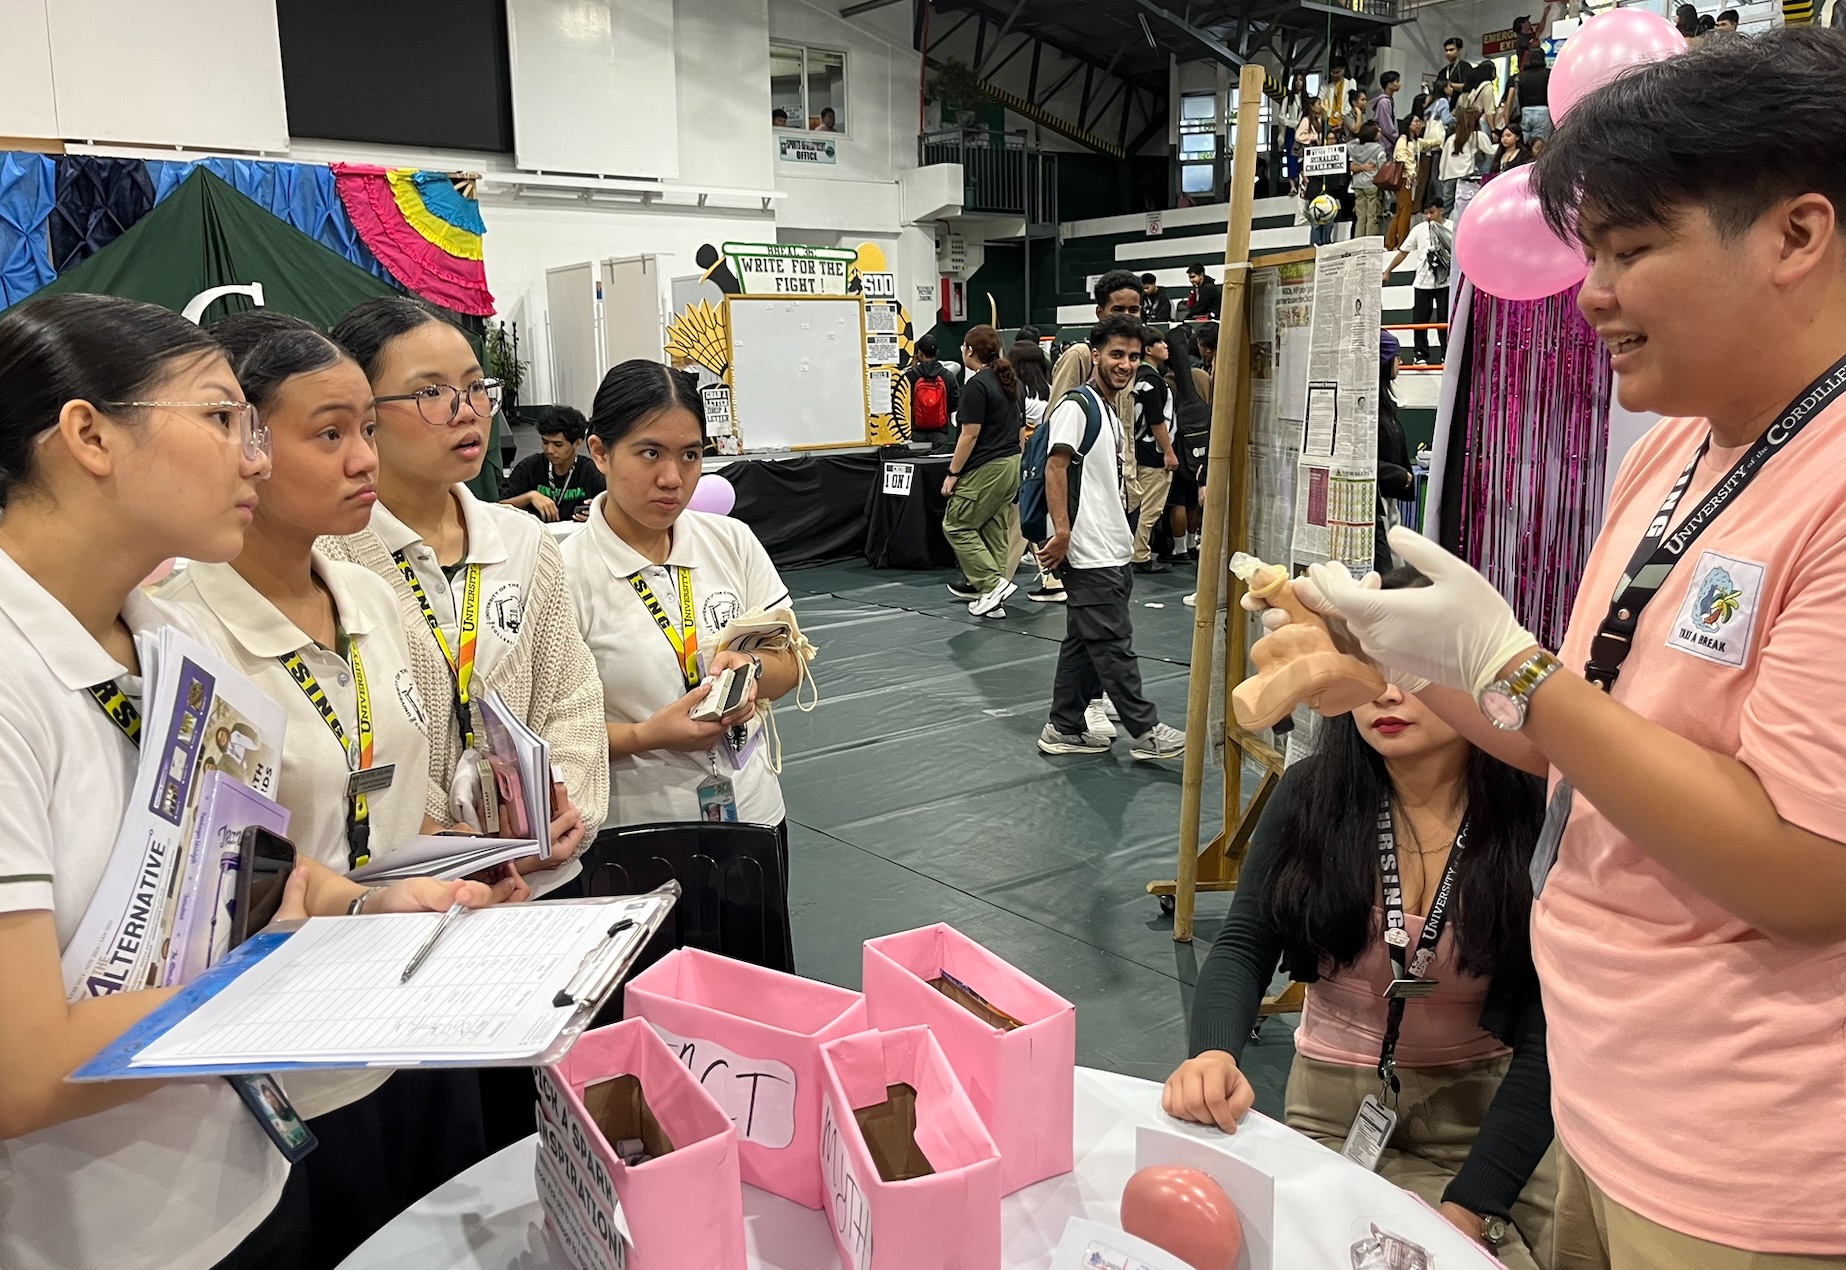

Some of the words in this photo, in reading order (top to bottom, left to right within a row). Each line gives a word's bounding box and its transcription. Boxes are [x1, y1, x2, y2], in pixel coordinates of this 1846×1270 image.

[1484, 24, 1538, 44] EMERGY
[1500, 40, 1517, 51] EXI
[1306, 162, 1344, 172] CHALLENGE
[741, 258, 784, 273] WRITE
[792, 260, 815, 275] FOR
[819, 262, 843, 276] THE
[775, 278, 815, 293] FIGHT
[1663, 464, 1747, 556] UNIVERSITY
[1756, 446, 1769, 459] the
[1767, 364, 1846, 445] CORDILLE
[892, 474, 904, 489] ON
[463, 568, 477, 632] UNIVERSITY
[682, 574, 694, 628] UNIVERSITY
[1698, 635, 1726, 652] BREAK
[353, 654, 371, 734] UNIVERSITY
[1421, 866, 1457, 941] UNIVERSITY
[87, 840, 166, 997] ALTERNATIVE
[91, 956, 110, 976] THE
[571, 1122, 614, 1209] SPARK
